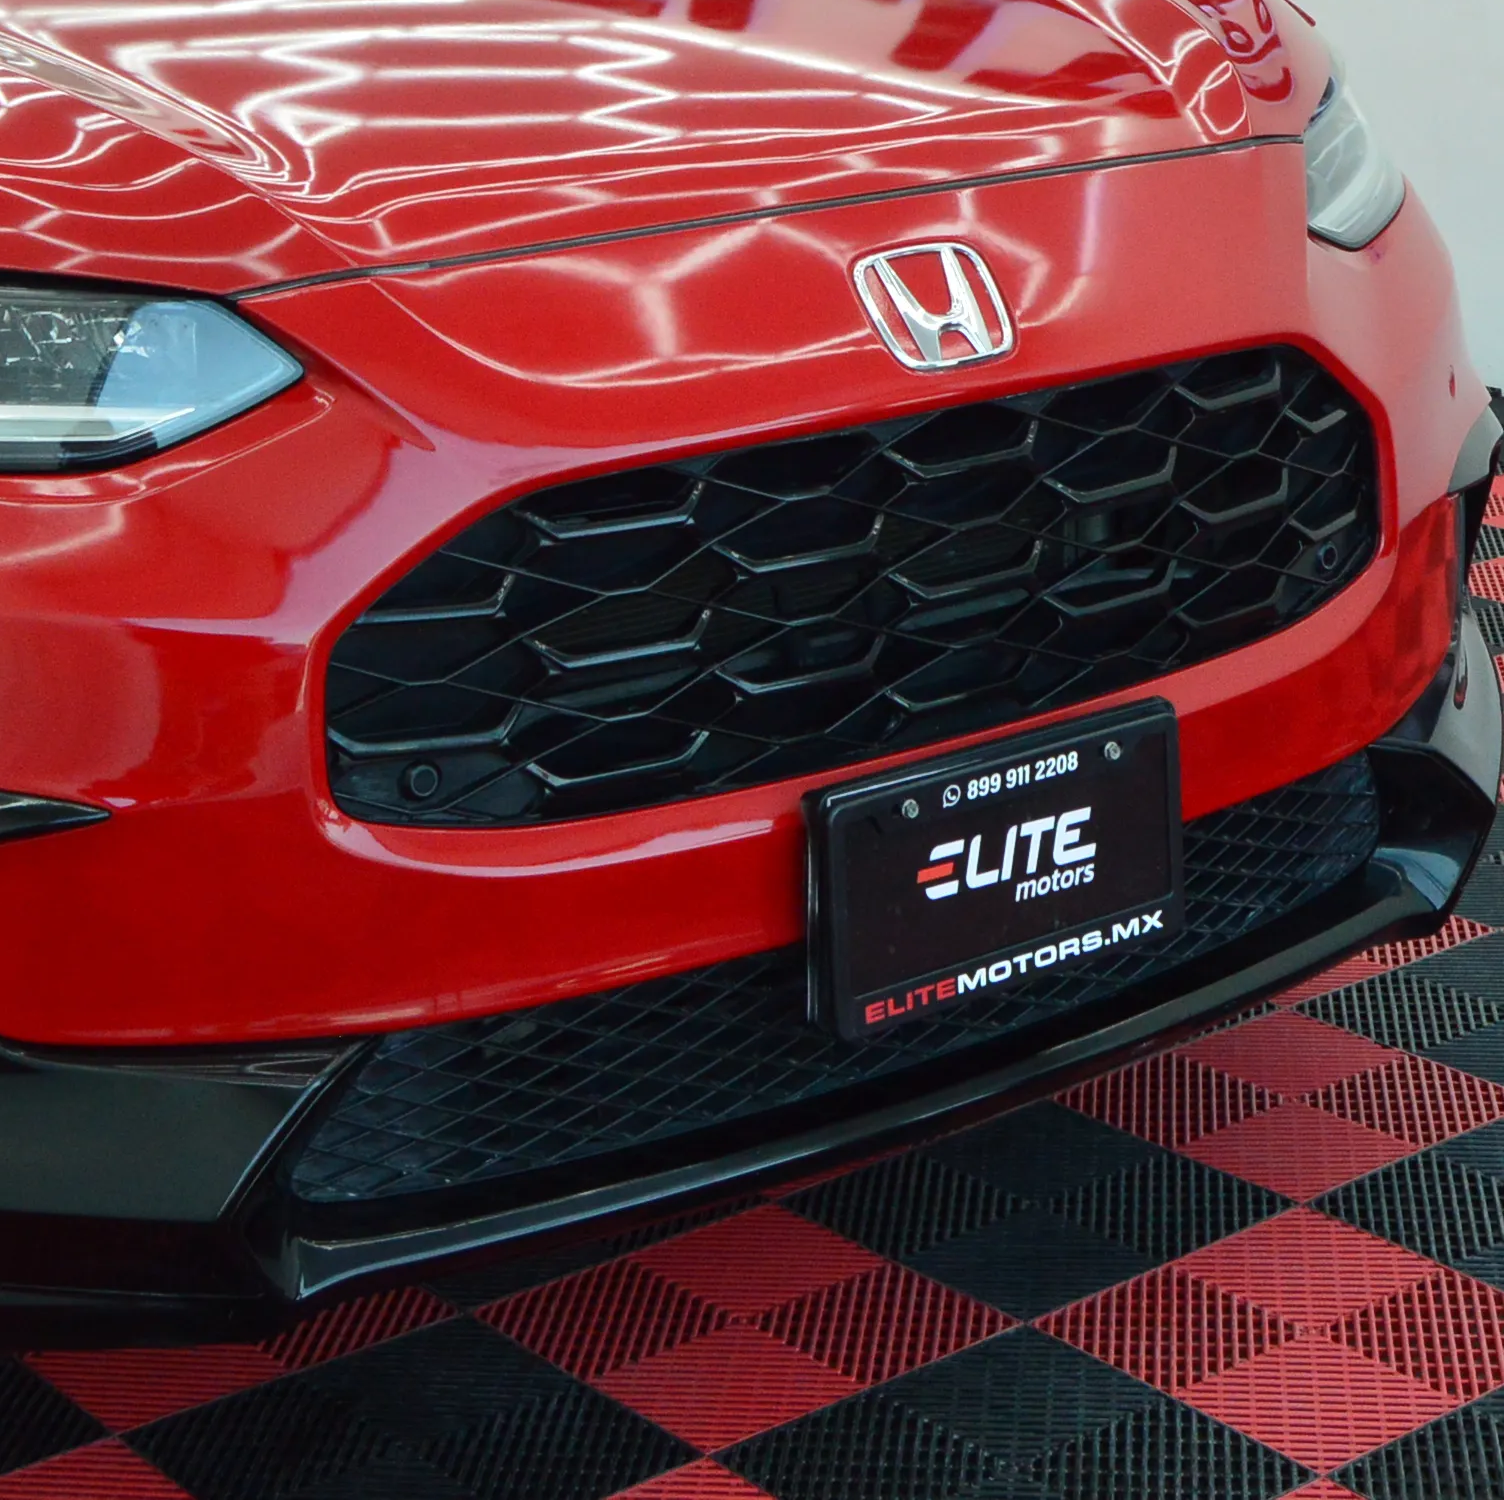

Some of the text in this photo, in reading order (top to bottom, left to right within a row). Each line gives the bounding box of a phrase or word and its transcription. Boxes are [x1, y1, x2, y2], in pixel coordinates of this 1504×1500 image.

[967, 751, 1079, 800] 899 911 2208
[917, 806, 1096, 900] ELITE
[1015, 863, 1095, 902] motors
[864, 909, 1164, 1024] ELITEMOTORS.MX
